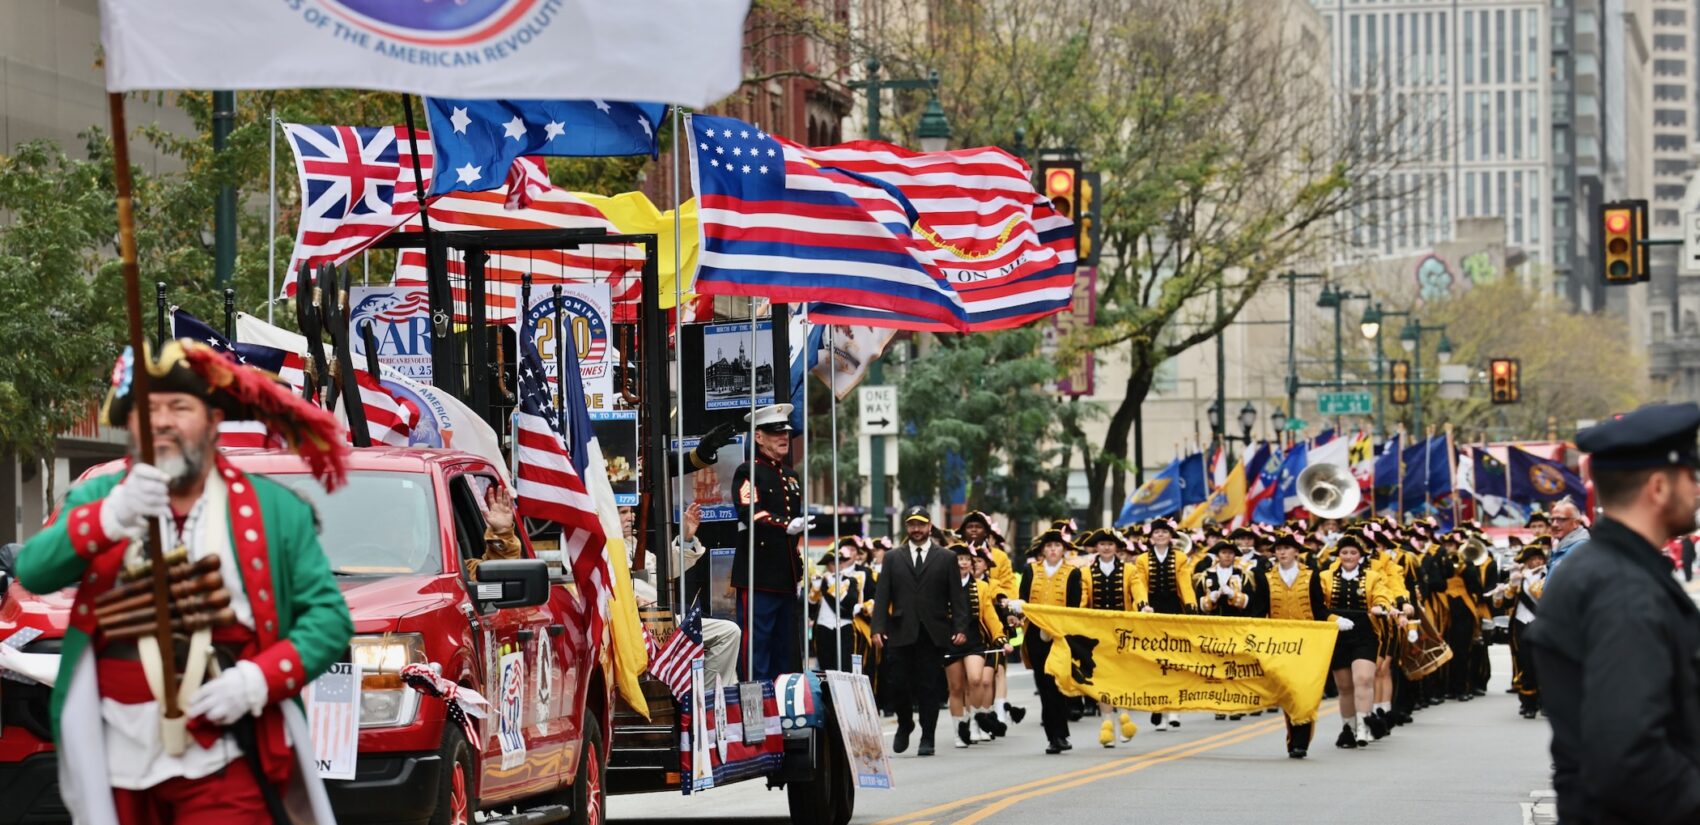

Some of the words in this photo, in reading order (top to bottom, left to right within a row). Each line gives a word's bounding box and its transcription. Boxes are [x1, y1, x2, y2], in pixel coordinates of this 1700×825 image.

[303, 7, 331, 29] OF
[332, 22, 370, 49] THE
[374, 40, 481, 69] AMERICAN
[484, 0, 567, 62] REVOLUTI
[957, 269, 988, 282] ON
[527, 299, 600, 328] HOMEOMING
[536, 316, 591, 360] 20
[403, 356, 433, 364] REVOLUTI
[418, 364, 433, 376] 25
[865, 390, 890, 400] ONE
[418, 387, 453, 429] AMERICA
[865, 404, 891, 414] WAY
[619, 496, 636, 504] 1779
[719, 509, 733, 519] 1775
[1114, 627, 1192, 653] Freedom
[1197, 634, 1238, 658] High
[1244, 633, 1304, 656] School
[1224, 658, 1265, 681] Band
[1178, 688, 1261, 706] Pennsylvania
